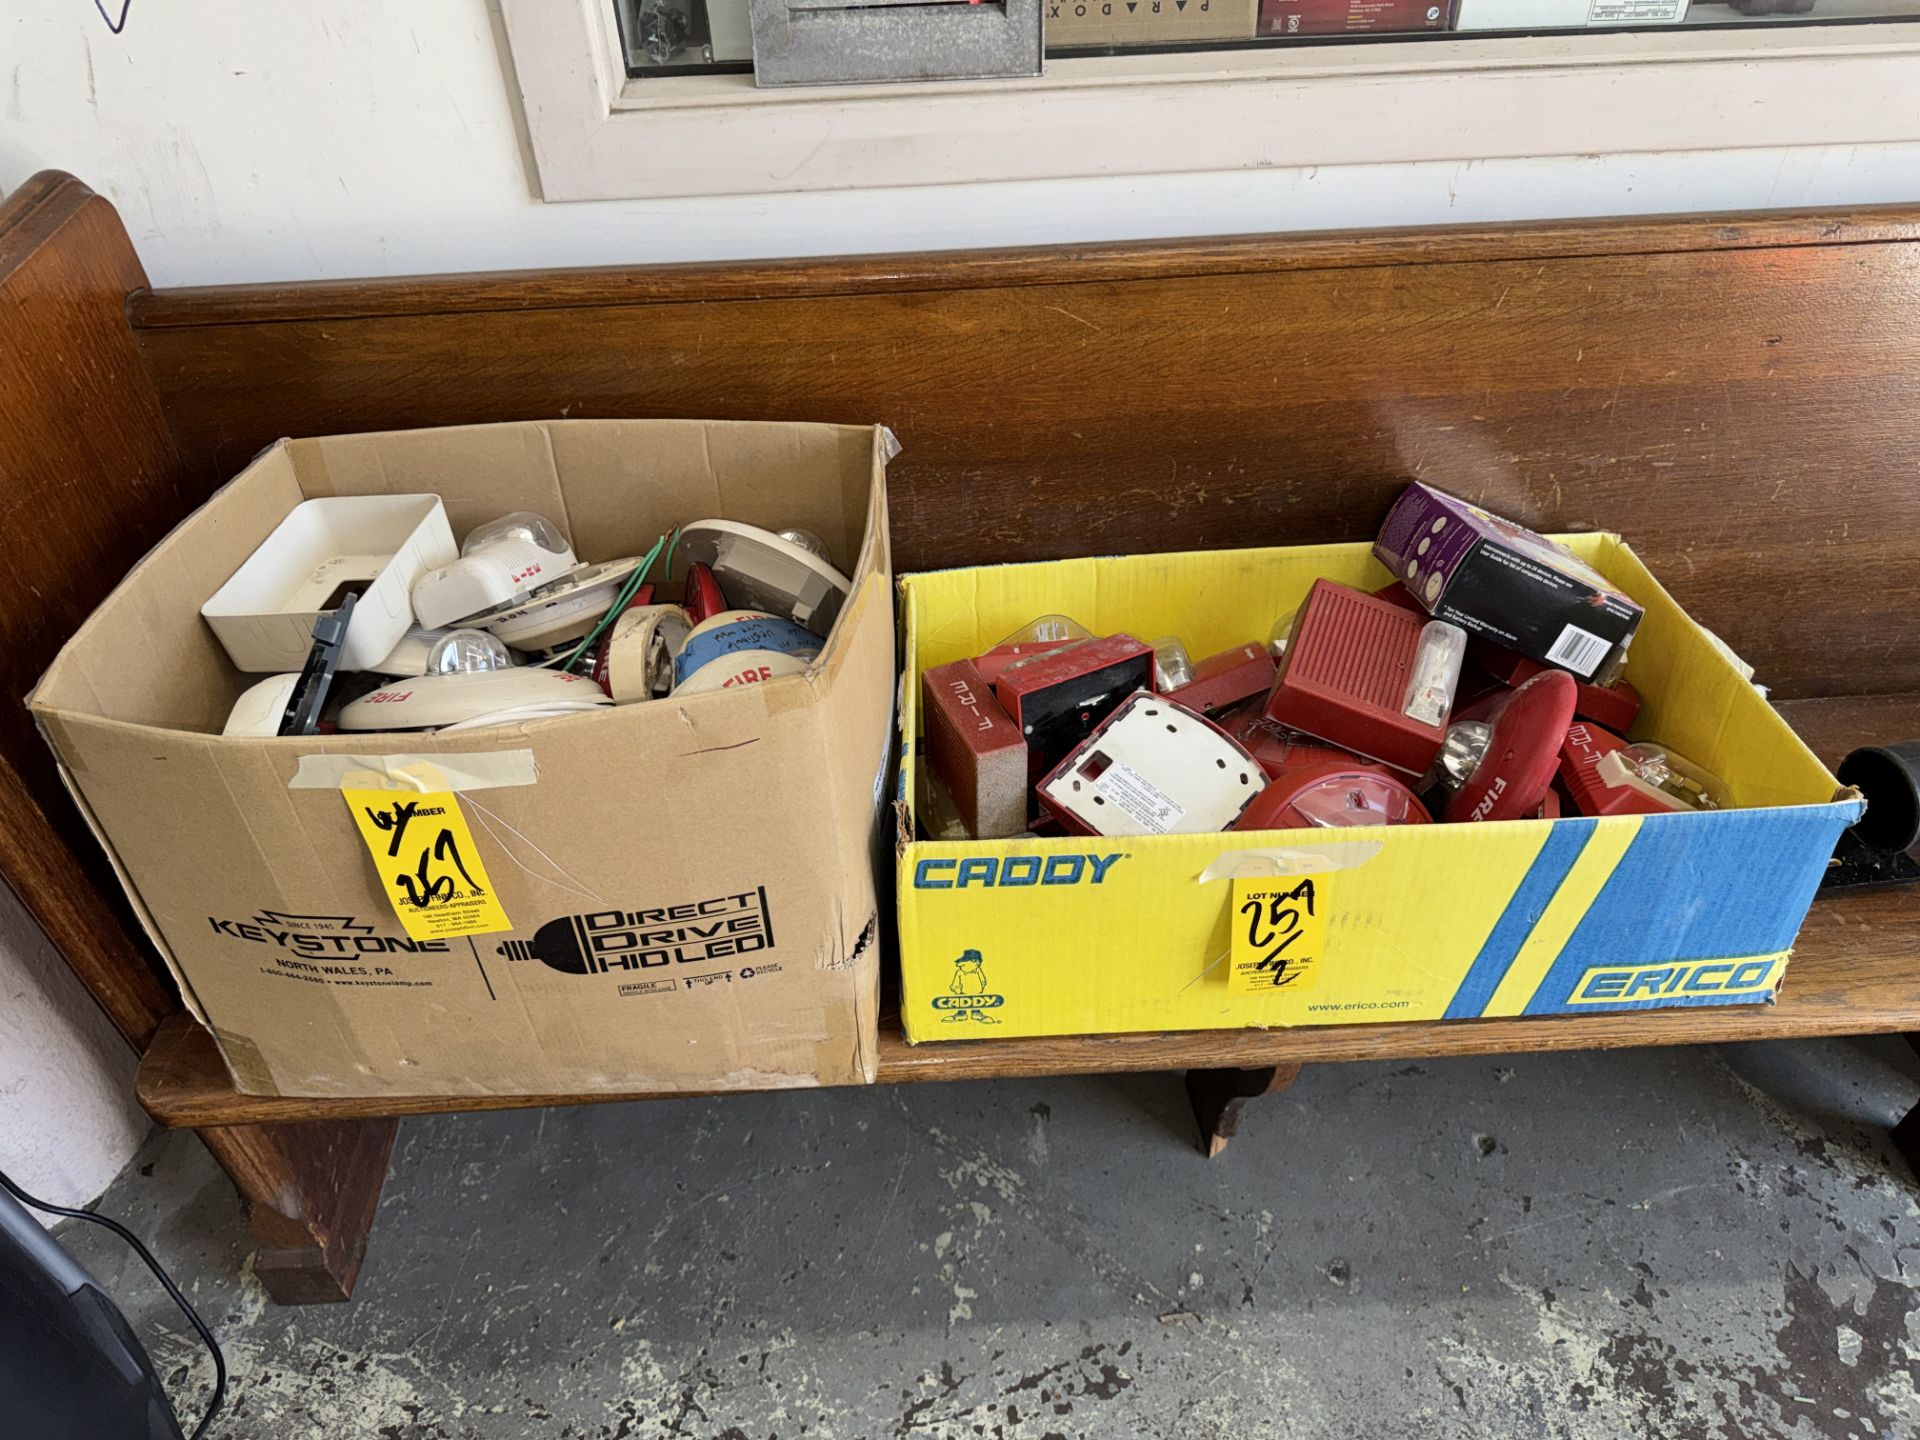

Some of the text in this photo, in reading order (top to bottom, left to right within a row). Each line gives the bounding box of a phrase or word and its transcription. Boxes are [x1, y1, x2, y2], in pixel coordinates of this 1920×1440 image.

[364, 691, 414, 704] FIRE
[1471, 776, 1507, 822] FIRE
[913, 853, 1124, 889] CADDY
[1247, 892, 1267, 900] LOT
[585, 892, 756, 931] DIRECT
[286, 920, 334, 930] SINCE 1945
[591, 915, 760, 952] DRIVE
[208, 916, 450, 953] KEYSTONE
[598, 934, 765, 973] HID LED
[275, 958, 320, 974] NORTH
[374, 967, 394, 976] PA
[1235, 961, 1262, 969] JOSEP
[621, 983, 657, 992] FRAGILE
[1580, 959, 1776, 998] ERICO
[937, 996, 997, 1008] CADDY
[1308, 1000, 1410, 1011] www.erico.com
